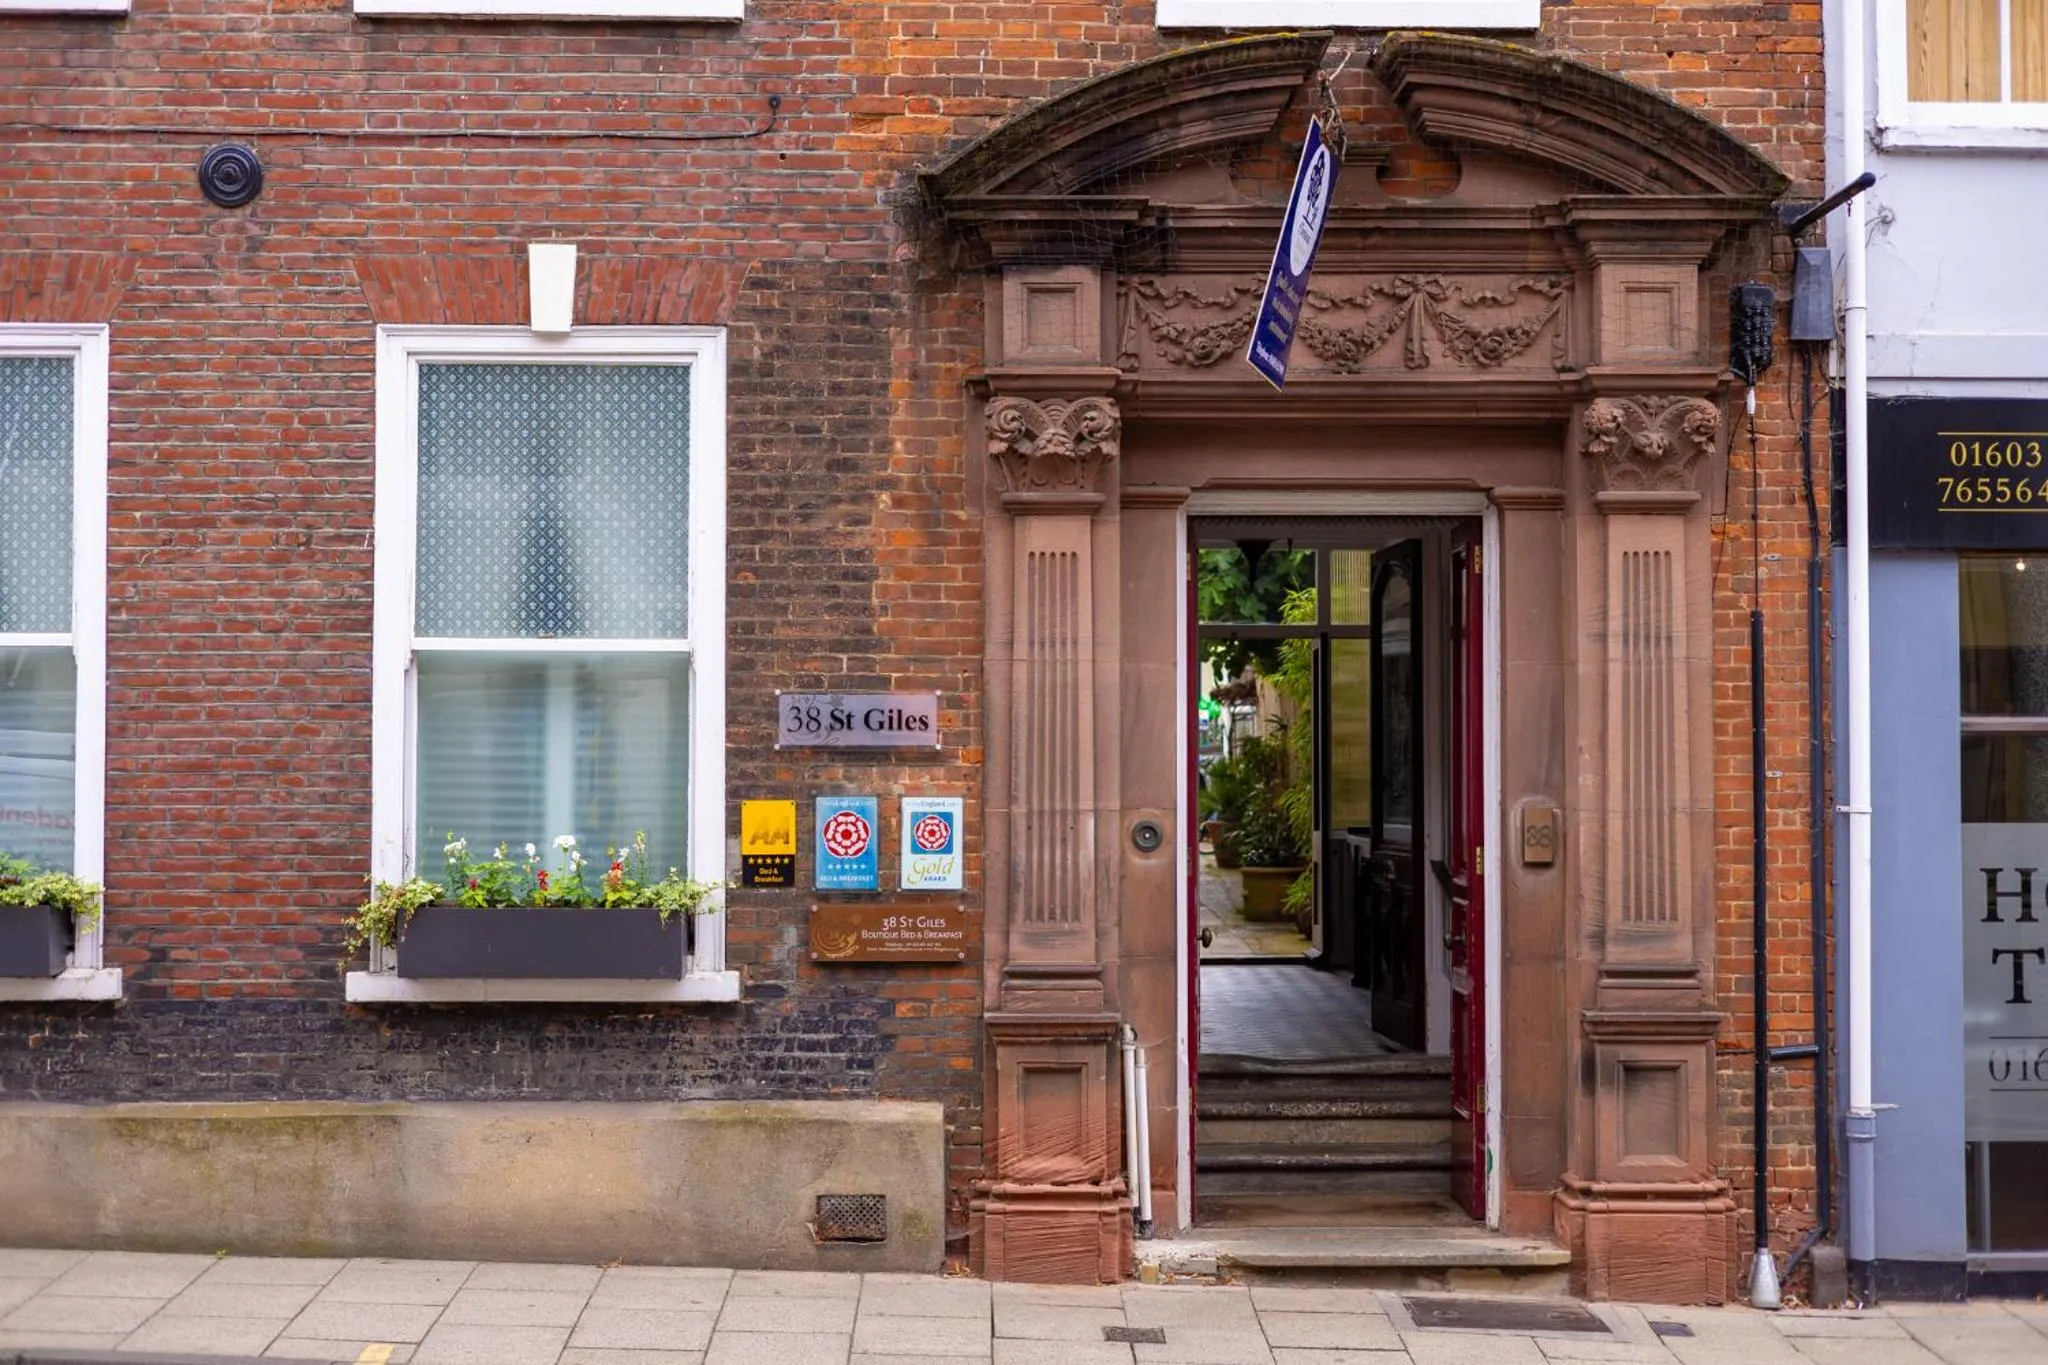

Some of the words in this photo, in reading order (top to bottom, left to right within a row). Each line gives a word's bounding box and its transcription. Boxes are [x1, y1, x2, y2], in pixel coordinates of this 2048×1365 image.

[1950, 441, 2042, 467] 01603
[1937, 477, 2048, 503] 765564
[787, 706, 821, 733] 38
[829, 708, 856, 731] St
[863, 708, 929, 732] Giles
[907, 856, 955, 885] Gold
[1980, 867, 2048, 923] H
[882, 916, 897, 931] 38
